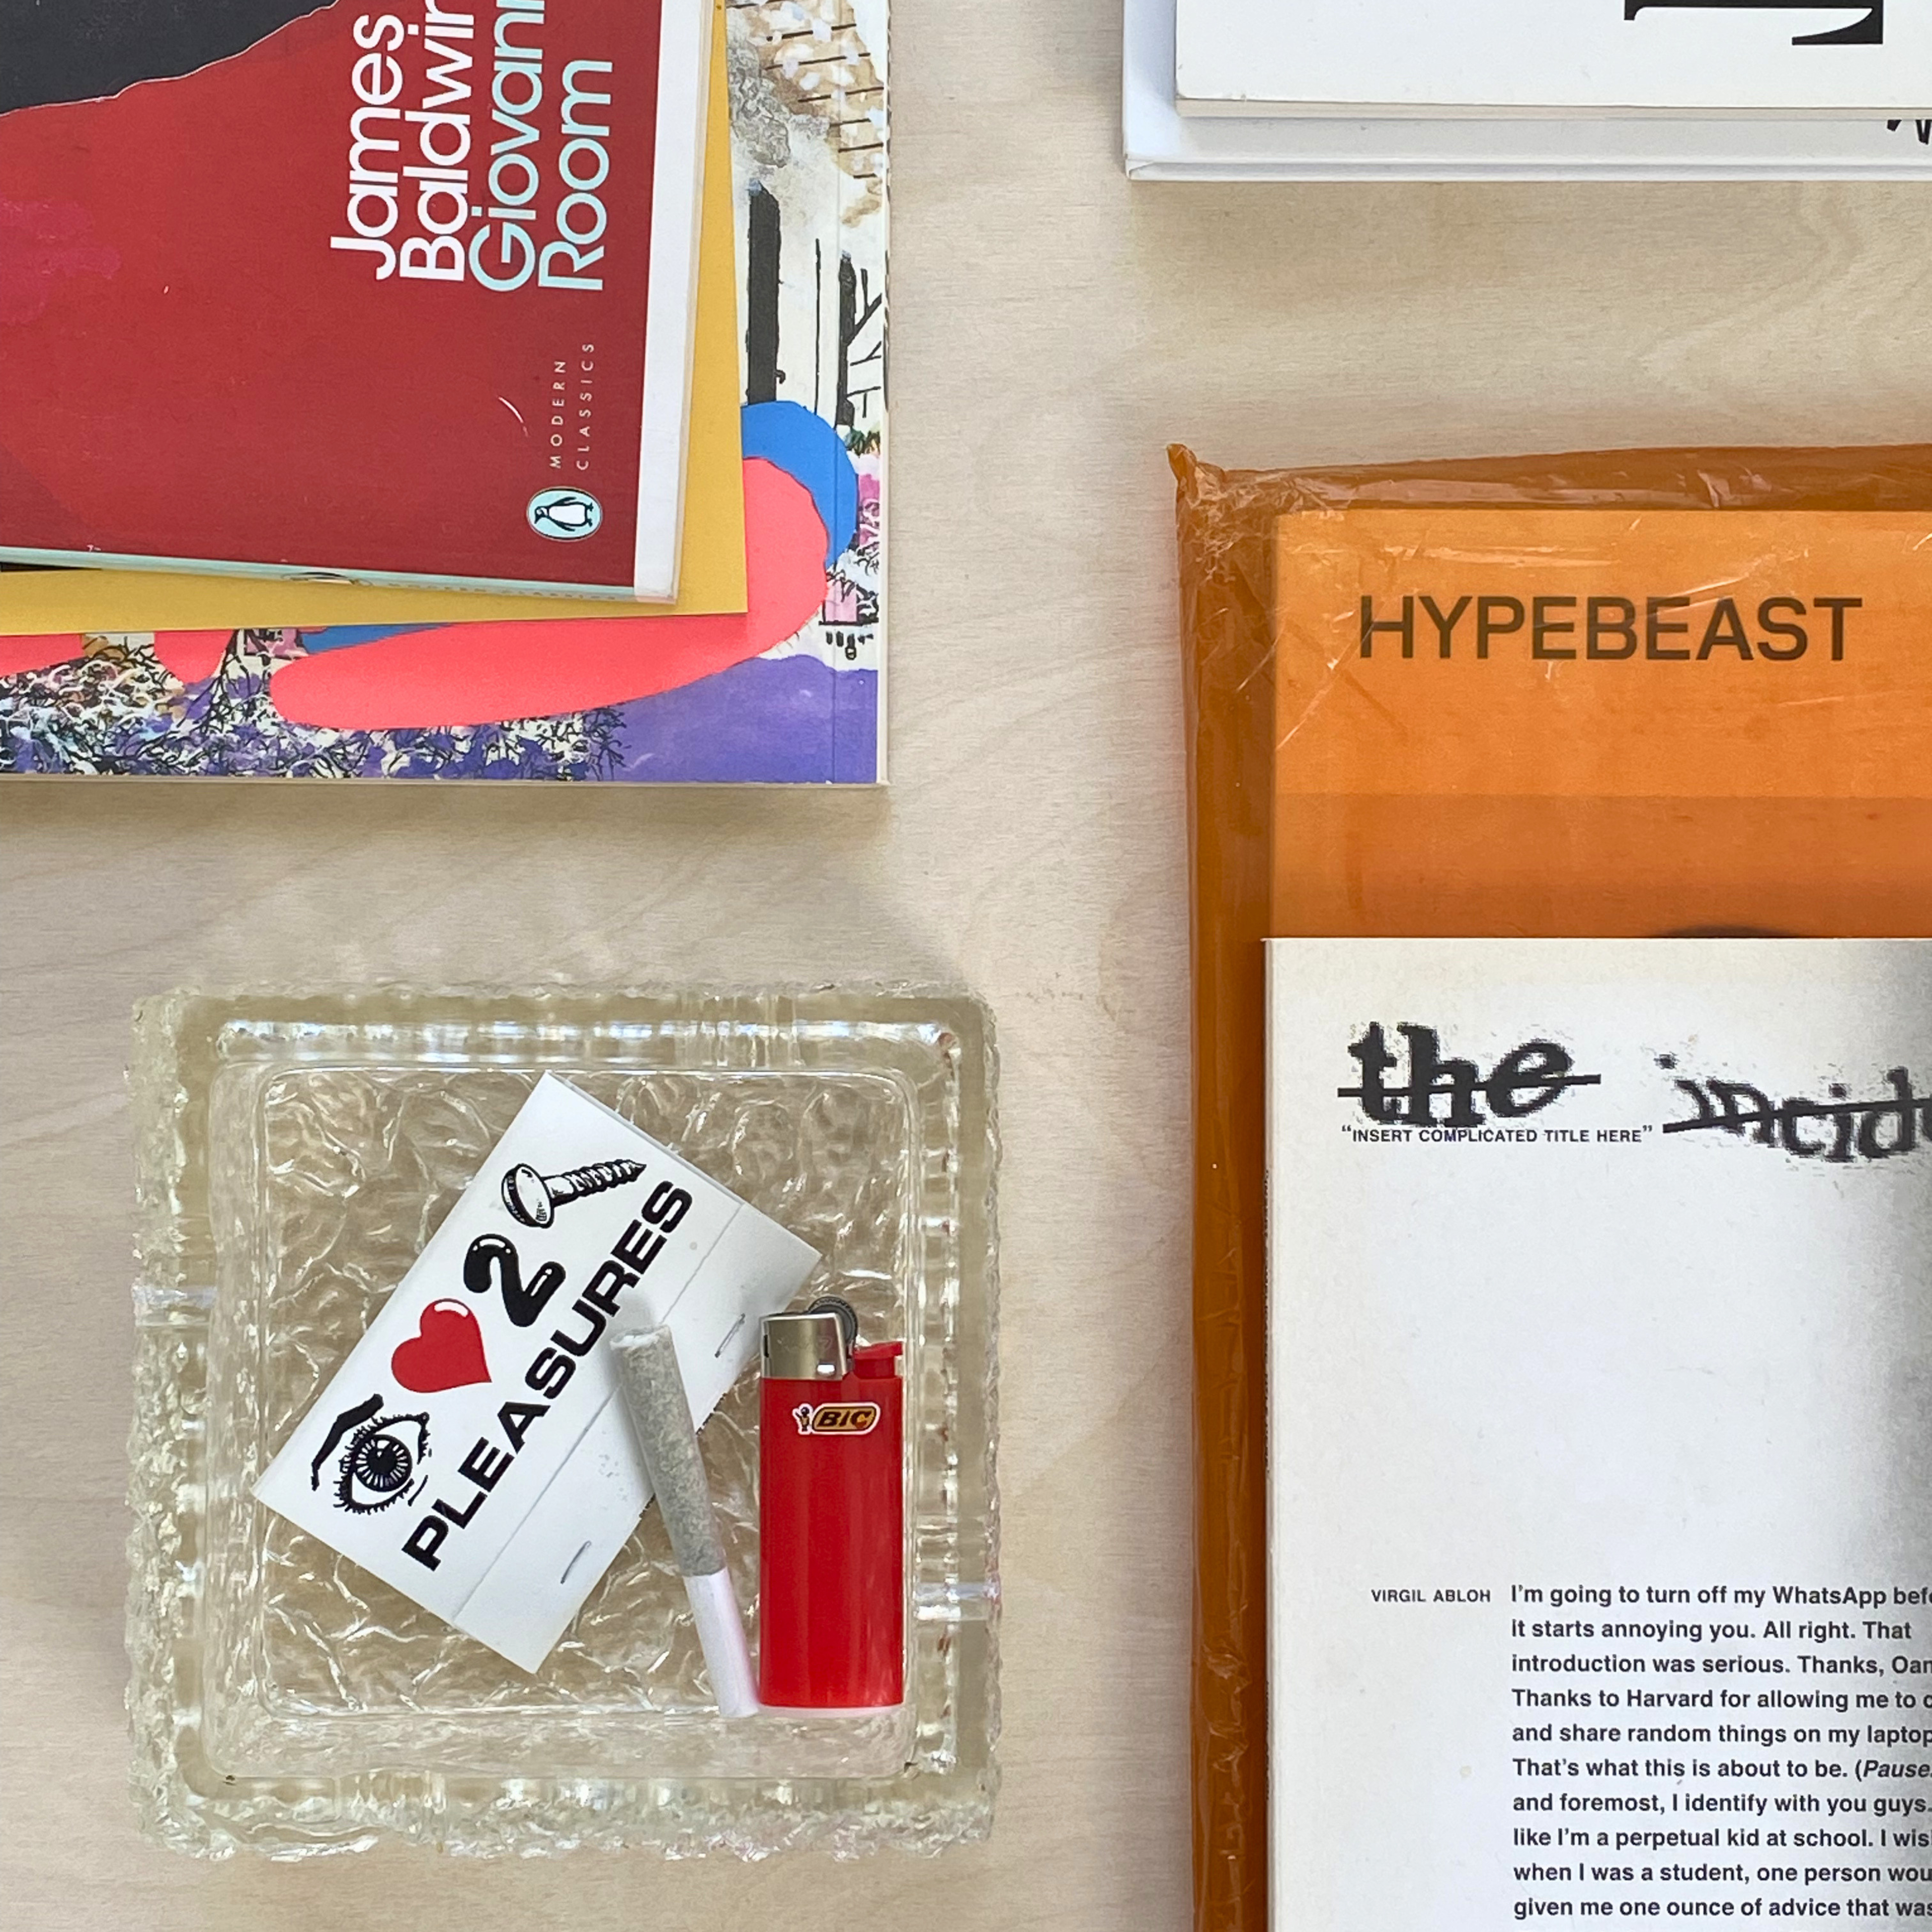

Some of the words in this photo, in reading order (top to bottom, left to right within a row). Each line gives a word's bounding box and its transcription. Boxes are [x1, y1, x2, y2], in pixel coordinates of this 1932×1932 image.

[330, 14, 405, 280] James
[469, 0, 545, 292] Giovan
[538, 60, 613, 290] Room
[550, 361, 566, 469] MODERN
[577, 344, 594, 470] CLASSICS
[1360, 596, 1863, 661] HYPEBEAST
[1347, 1021, 1575, 1128] the
[1655, 1053, 1932, 1163] incid
[1419, 1129, 1538, 1142] COMPLICATED
[1545, 1130, 1590, 1142] TITLE
[401, 1180, 693, 1571] PLEASURES
[816, 1410, 872, 1429] BIC
[1371, 1589, 1426, 1602] VIRGIL
[1433, 1589, 1490, 1602] ABLOH
[1550, 1584, 1612, 1607] going
[1619, 1586, 1640, 1603] to
[1646, 1586, 1690, 1603] turn
[1697, 1585, 1727, 1603] off
[1734, 1590, 1765, 1608] my
[1772, 1586, 1887, 1609] WhatsApp
[1512, 1619, 1525, 1637] it
[1532, 1620, 1594, 1638] starts
[1601, 1620, 1702, 1643] annoying
[1709, 1624, 1755, 1643] you.
[1763, 1621, 1791, 1639] All
[1799, 1621, 1856, 1643] right.
[1862, 1621, 1911, 1639] That
[1512, 1654, 1645, 1672] introduction
[1652, 1659, 1695, 1672] was
[1702, 1655, 1791, 1673] serious.
[1797, 1655, 1884, 1677] Thanks,
[1511, 1688, 1591, 1707] Thanks
[1598, 1689, 1619, 1707] to
[1627, 1689, 1713, 1708] Harvard
[1720, 1689, 1751, 1708] for
[1757, 1689, 1848, 1713] allowing
[1856, 1695, 1889, 1709] me
[1895, 1691, 1916, 1708] to
[1512, 1723, 1552, 1741] and
[1559, 1723, 1621, 1742] share
[1628, 1724, 1711, 1742] random
[1718, 1724, 1787, 1747] things
[1794, 1729, 1821, 1743] on
[1828, 1729, 1860, 1748] my
[1586, 1758, 1639, 1777] what
[1645, 1758, 1685, 1777] this
[1693, 1759, 1710, 1777] is
[1717, 1759, 1781, 1777] about
[1787, 1760, 1808, 1777] to
[1815, 1759, 1847, 1778] be.
[1513, 1793, 1553, 1811] and
[1559, 1793, 1665, 1815] foremost,
[1673, 1793, 1677, 1811] I
[1685, 1793, 1767, 1816] identify
[1774, 1794, 1820, 1812] with
[1827, 1798, 1867, 1816] you
[1874, 1798, 1932, 1817] guys.
[1514, 1828, 1551, 1846] like
[1597, 1832, 1609, 1846] a
[1616, 1828, 1719, 1850] perpetual
[1727, 1828, 1759, 1846] kid
[1766, 1829, 1787, 1846] at
[1793, 1828, 1873, 1846] school.
[1881, 1829, 1886, 1846] I
[1893, 1828, 1932, 1847] wis
[1513, 1863, 1571, 1881] when
[1579, 1863, 1584, 1881] I
[1591, 1867, 1634, 1881] was
[1641, 1867, 1653, 1881] a
[1660, 1863, 1749, 1885] student,
[1757, 1868, 1798, 1881] one
[1804, 1868, 1881, 1886] person
[1514, 1897, 1573, 1920] given
[1581, 1902, 1613, 1916] me
[1620, 1902, 1660, 1916] one
[1667, 1902, 1734, 1916] ounce
[1741, 1898, 1762, 1916] of
[1769, 1898, 1840, 1916] advice
[1846, 1898, 1889, 1917] that
